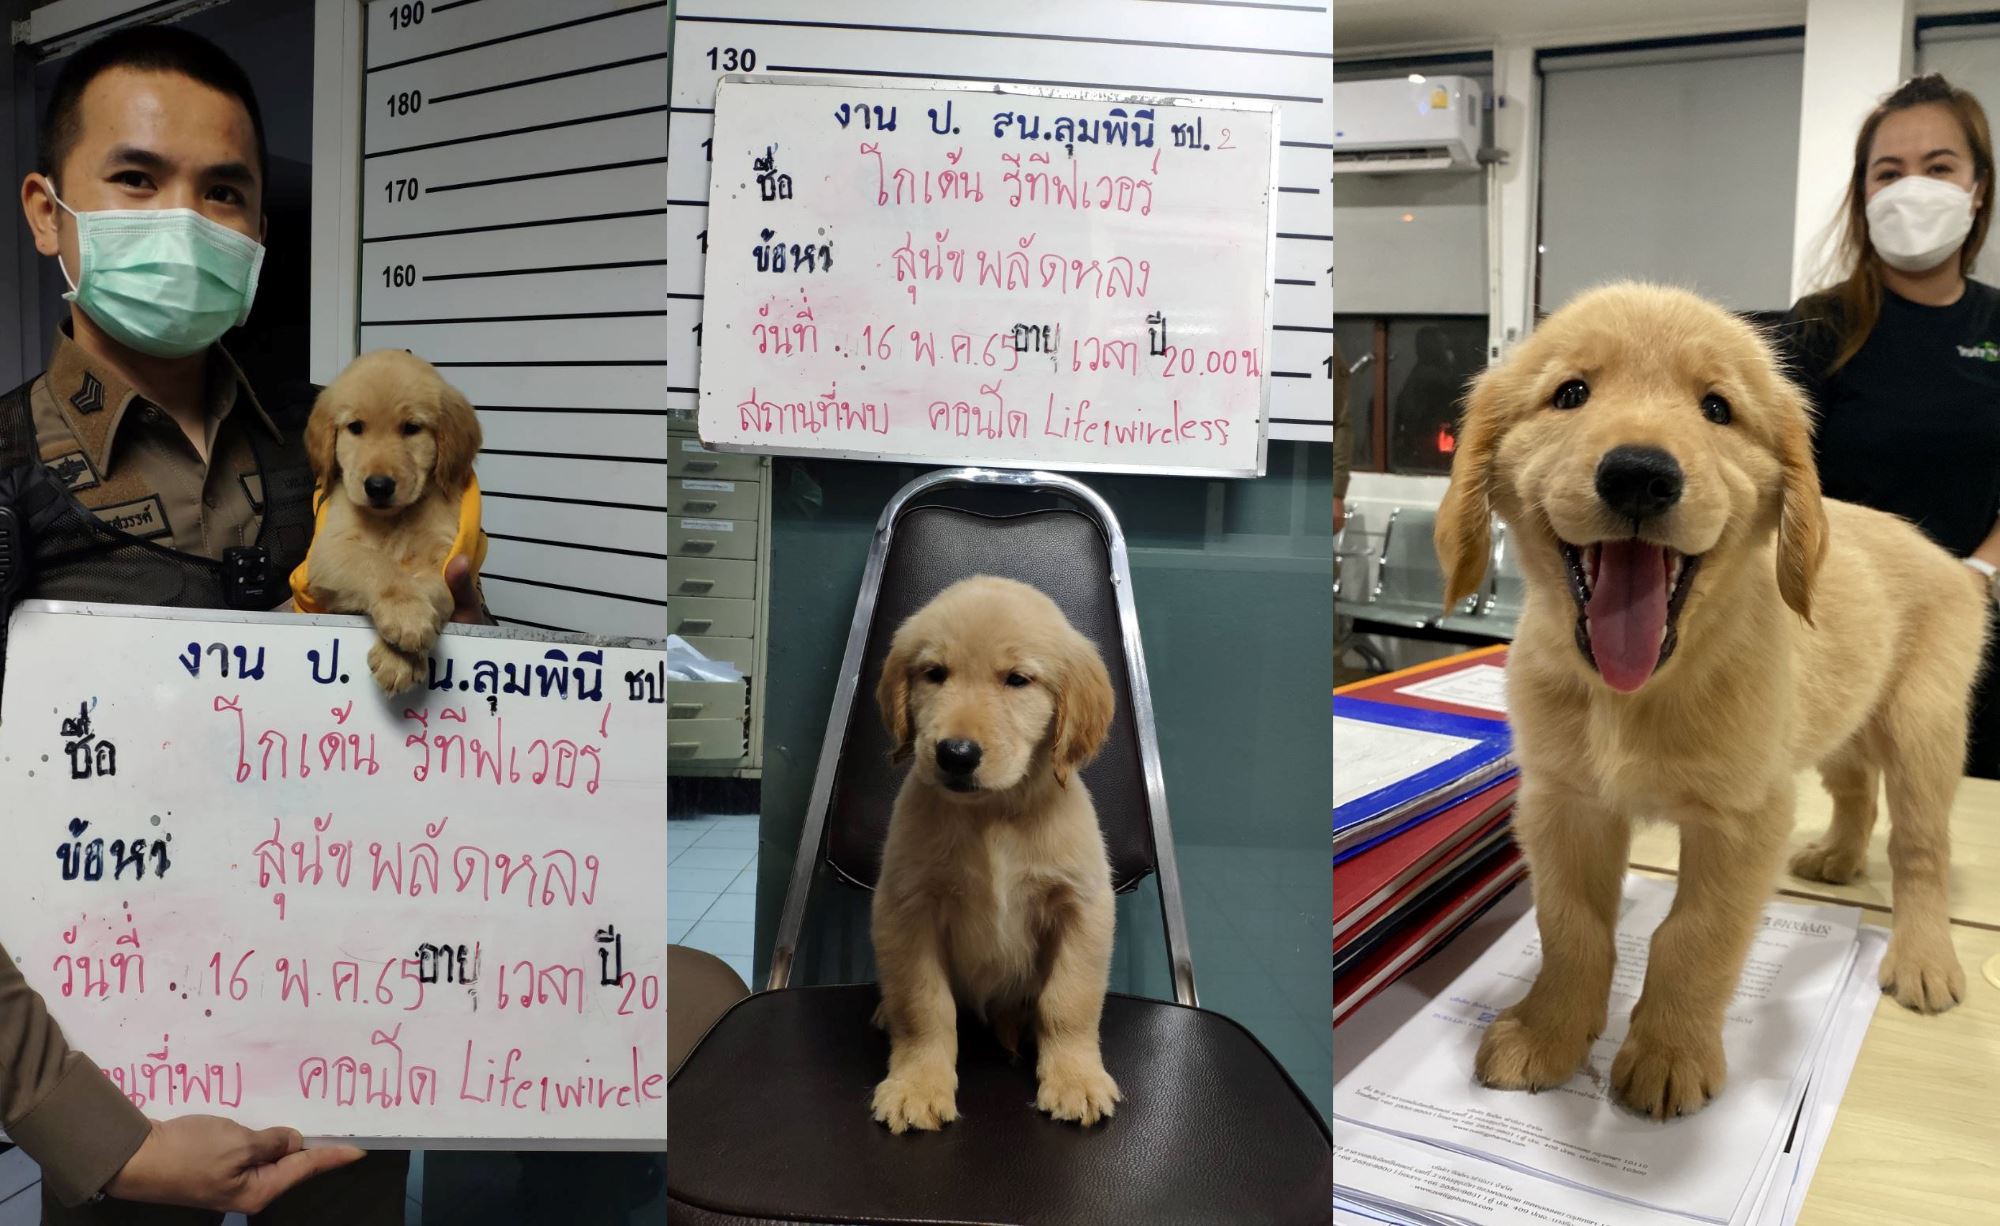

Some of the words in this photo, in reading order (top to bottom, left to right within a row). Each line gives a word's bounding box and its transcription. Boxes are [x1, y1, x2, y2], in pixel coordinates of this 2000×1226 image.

[389, 0, 425, 30] 190
[706, 47, 758, 73] 130
[387, 90, 421, 117] 180
[834, 102, 897, 132] งาน
[927, 100, 960, 135] ป.
[993, 108, 1155, 158] สน.ลุมพินี
[1171, 116, 1210, 151] ชป.
[385, 178, 419, 203] 170
[753, 143, 793, 201] ชื่อ
[861, 142, 984, 206] โกเด้น
[382, 264, 416, 288] 160
[752, 228, 834, 273] ข้อหา
[752, 295, 817, 354] วันที่
[863, 324, 896, 360] 16
[1072, 337, 1137, 376] เวลา
[1146, 310, 1166, 356] ปี
[737, 381, 889, 436] สถานที่พบ
[929, 379, 1028, 439] คอนโด
[178, 642, 265, 681] งาน
[307, 638, 350, 684] ป.
[427, 648, 603, 716] น.ลุมพินี
[60, 697, 116, 779] ชื่อ
[214, 695, 380, 783] โกเด้น
[56, 817, 171, 881] ข้อหา
[53, 913, 145, 998] วันที่
[209, 949, 255, 1000] 16
[497, 960, 584, 1014] เวลา
[594, 924, 622, 986] ปี
[299, 1022, 436, 1109] คอนโด
